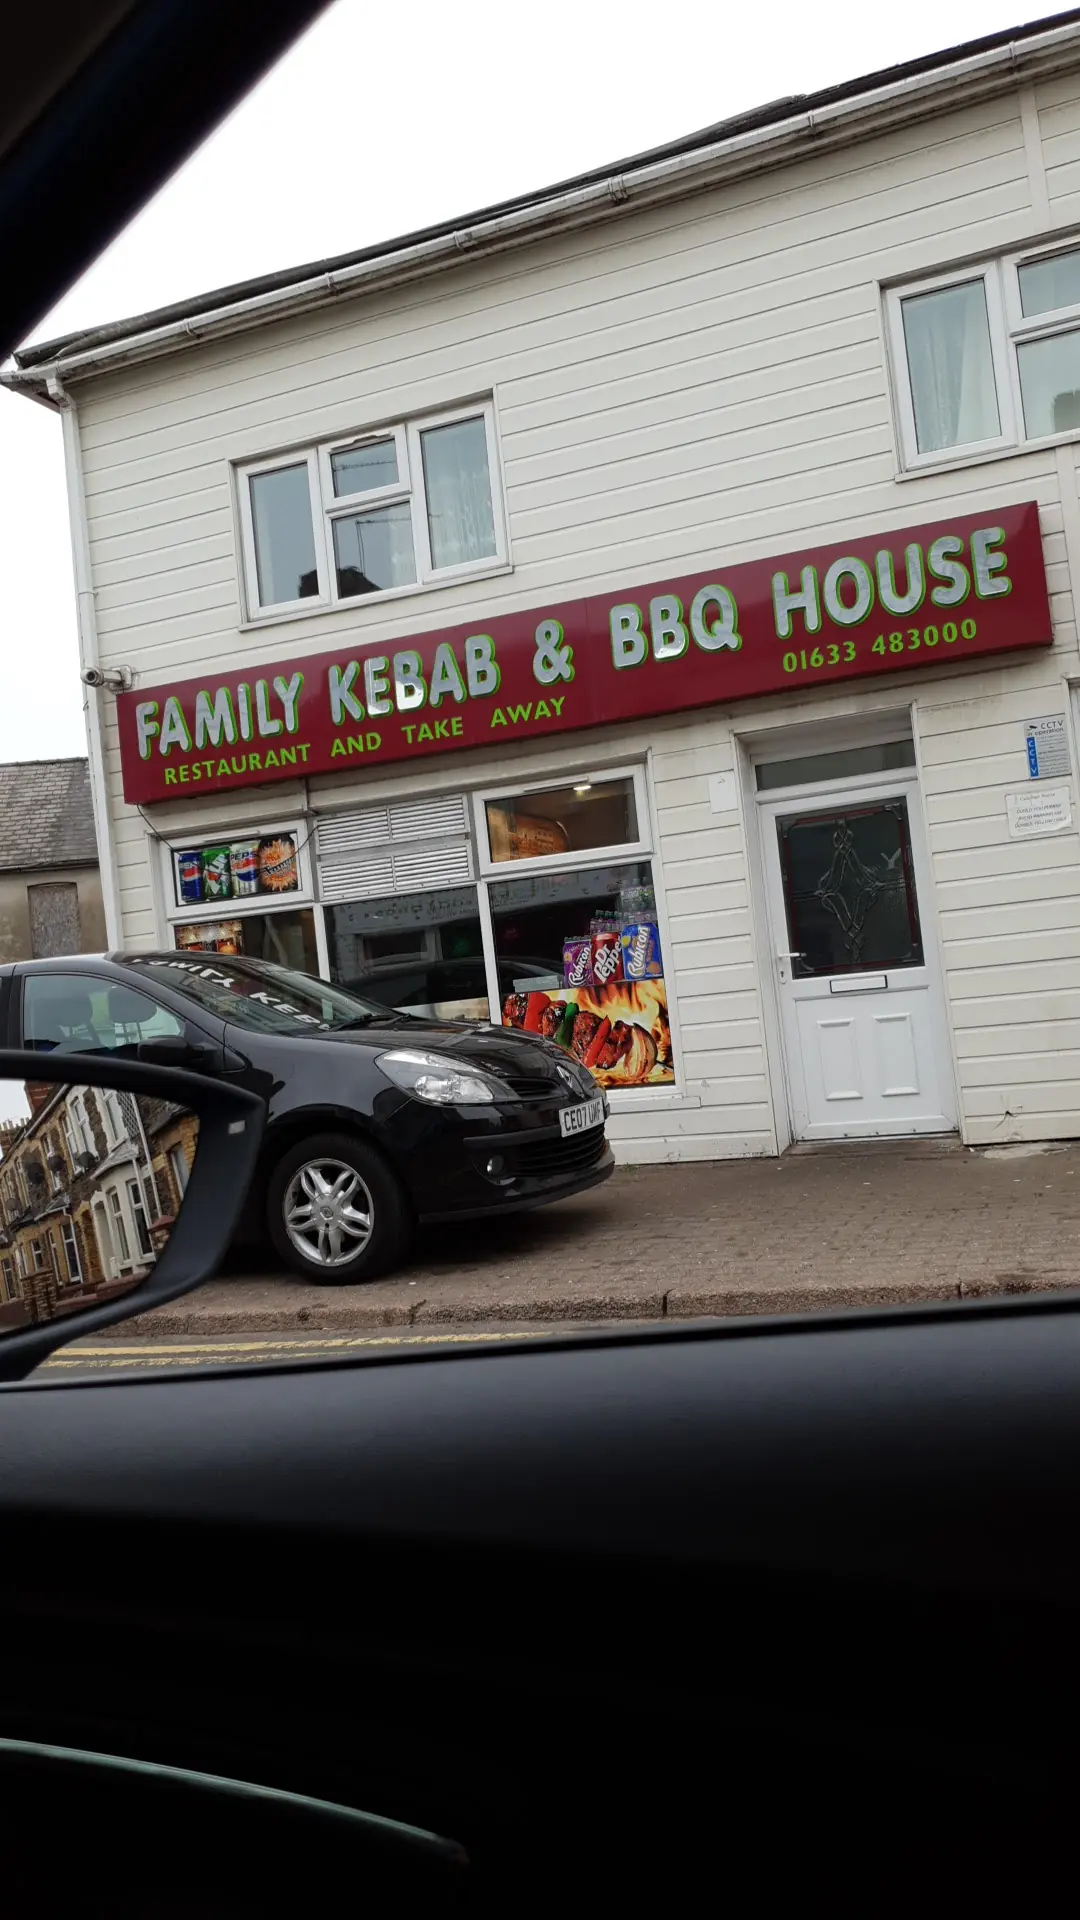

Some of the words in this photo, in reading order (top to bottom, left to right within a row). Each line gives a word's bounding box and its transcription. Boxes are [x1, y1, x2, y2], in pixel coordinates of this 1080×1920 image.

[135, 672, 304, 760] FAMILY
[328, 634, 501, 726] KEBAB
[532, 619, 574, 685] &
[609, 584, 743, 670] BBQ
[772, 526, 1012, 639] HOUSE
[783, 640, 857, 673] 01633
[871, 619, 977, 656] 483000
[164, 743, 311, 785] RESTAURANT
[330, 732, 381, 757] AND
[402, 716, 464, 745] TAKE
[490, 696, 566, 728] AWAY
[1035, 727, 1064, 736] operation
[1040, 720, 1064, 730] CCTV
[1028, 741, 1037, 774] CCTV
[568, 946, 591, 985] Rubicon
[595, 944, 611, 962] Dr
[627, 926, 650, 977] Rubicon
[564, 1106, 587, 1131] CE07
